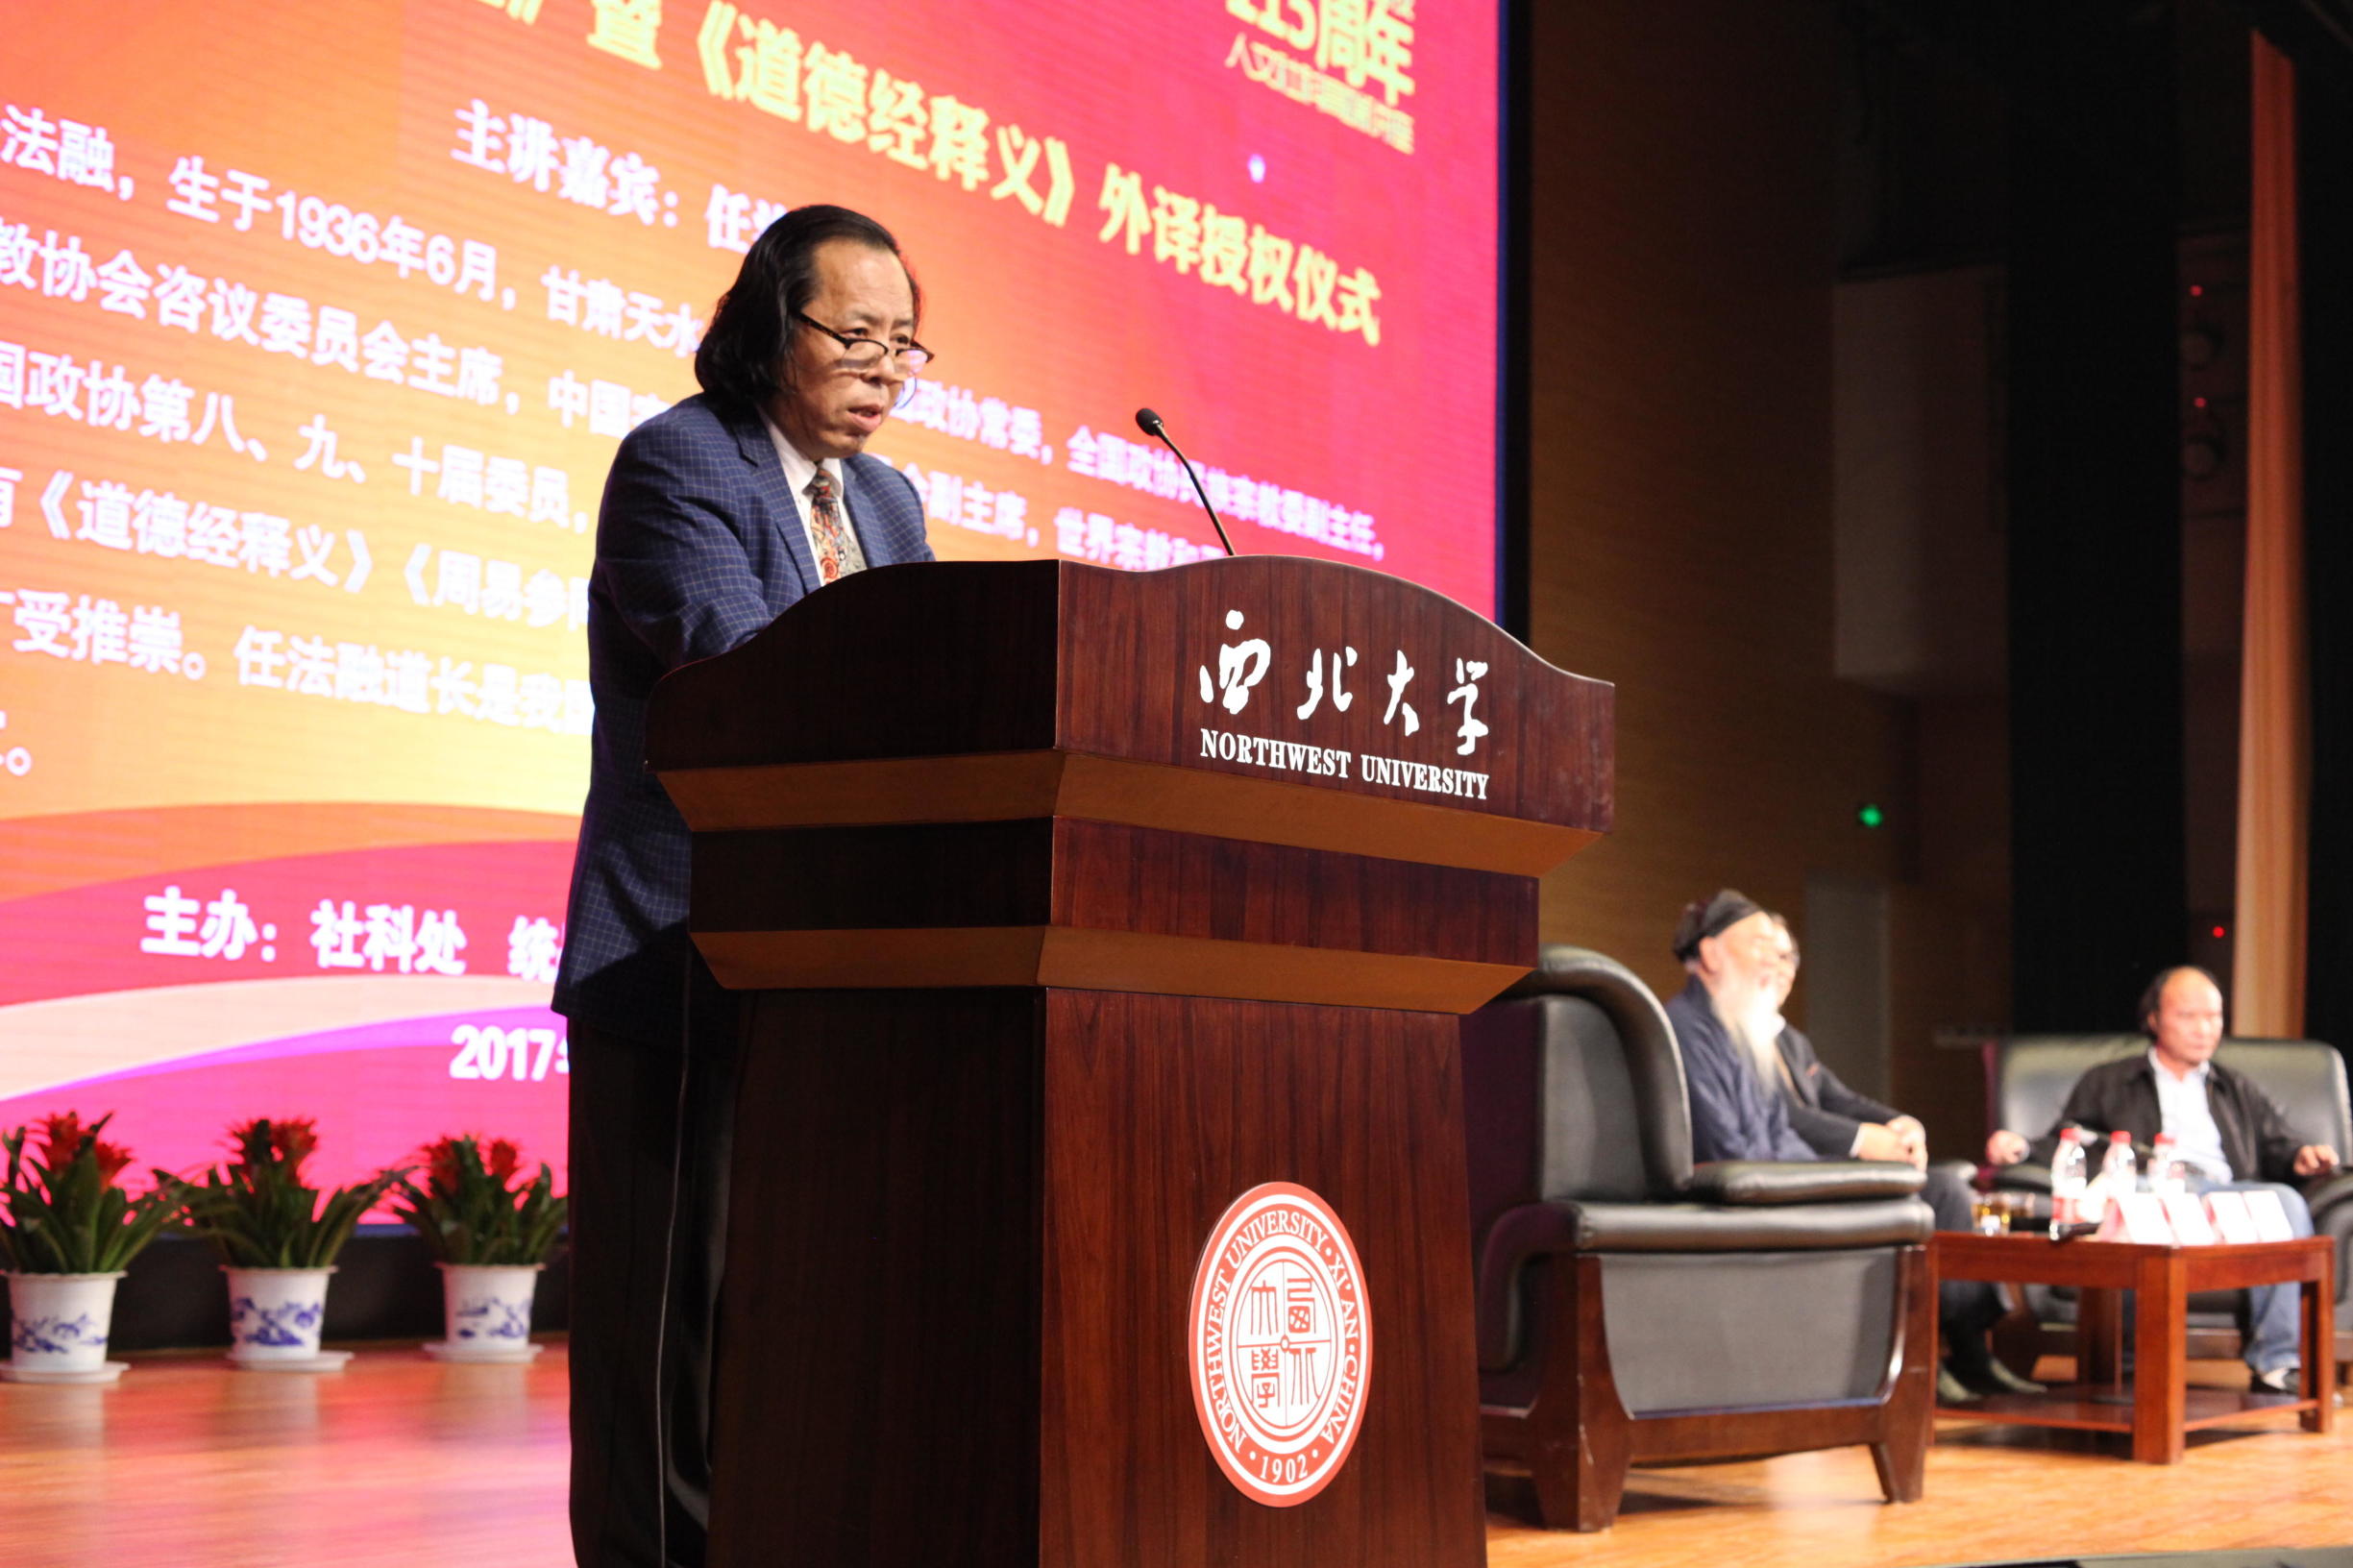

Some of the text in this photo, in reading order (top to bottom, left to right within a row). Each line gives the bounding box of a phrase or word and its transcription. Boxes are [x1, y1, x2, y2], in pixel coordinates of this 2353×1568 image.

[1199, 609, 1489, 756] 西北大学
[1200, 728, 1489, 800] NORTHWEST UNIVERSITY
[507, 916, 565, 984] 统
[1225, 1210, 1329, 1273] UNIVERSITY
[1206, 1269, 1248, 1453] NORTHWEST
[1320, 1352, 1360, 1445] CHINA
[1259, 1455, 1309, 1483] 1902
